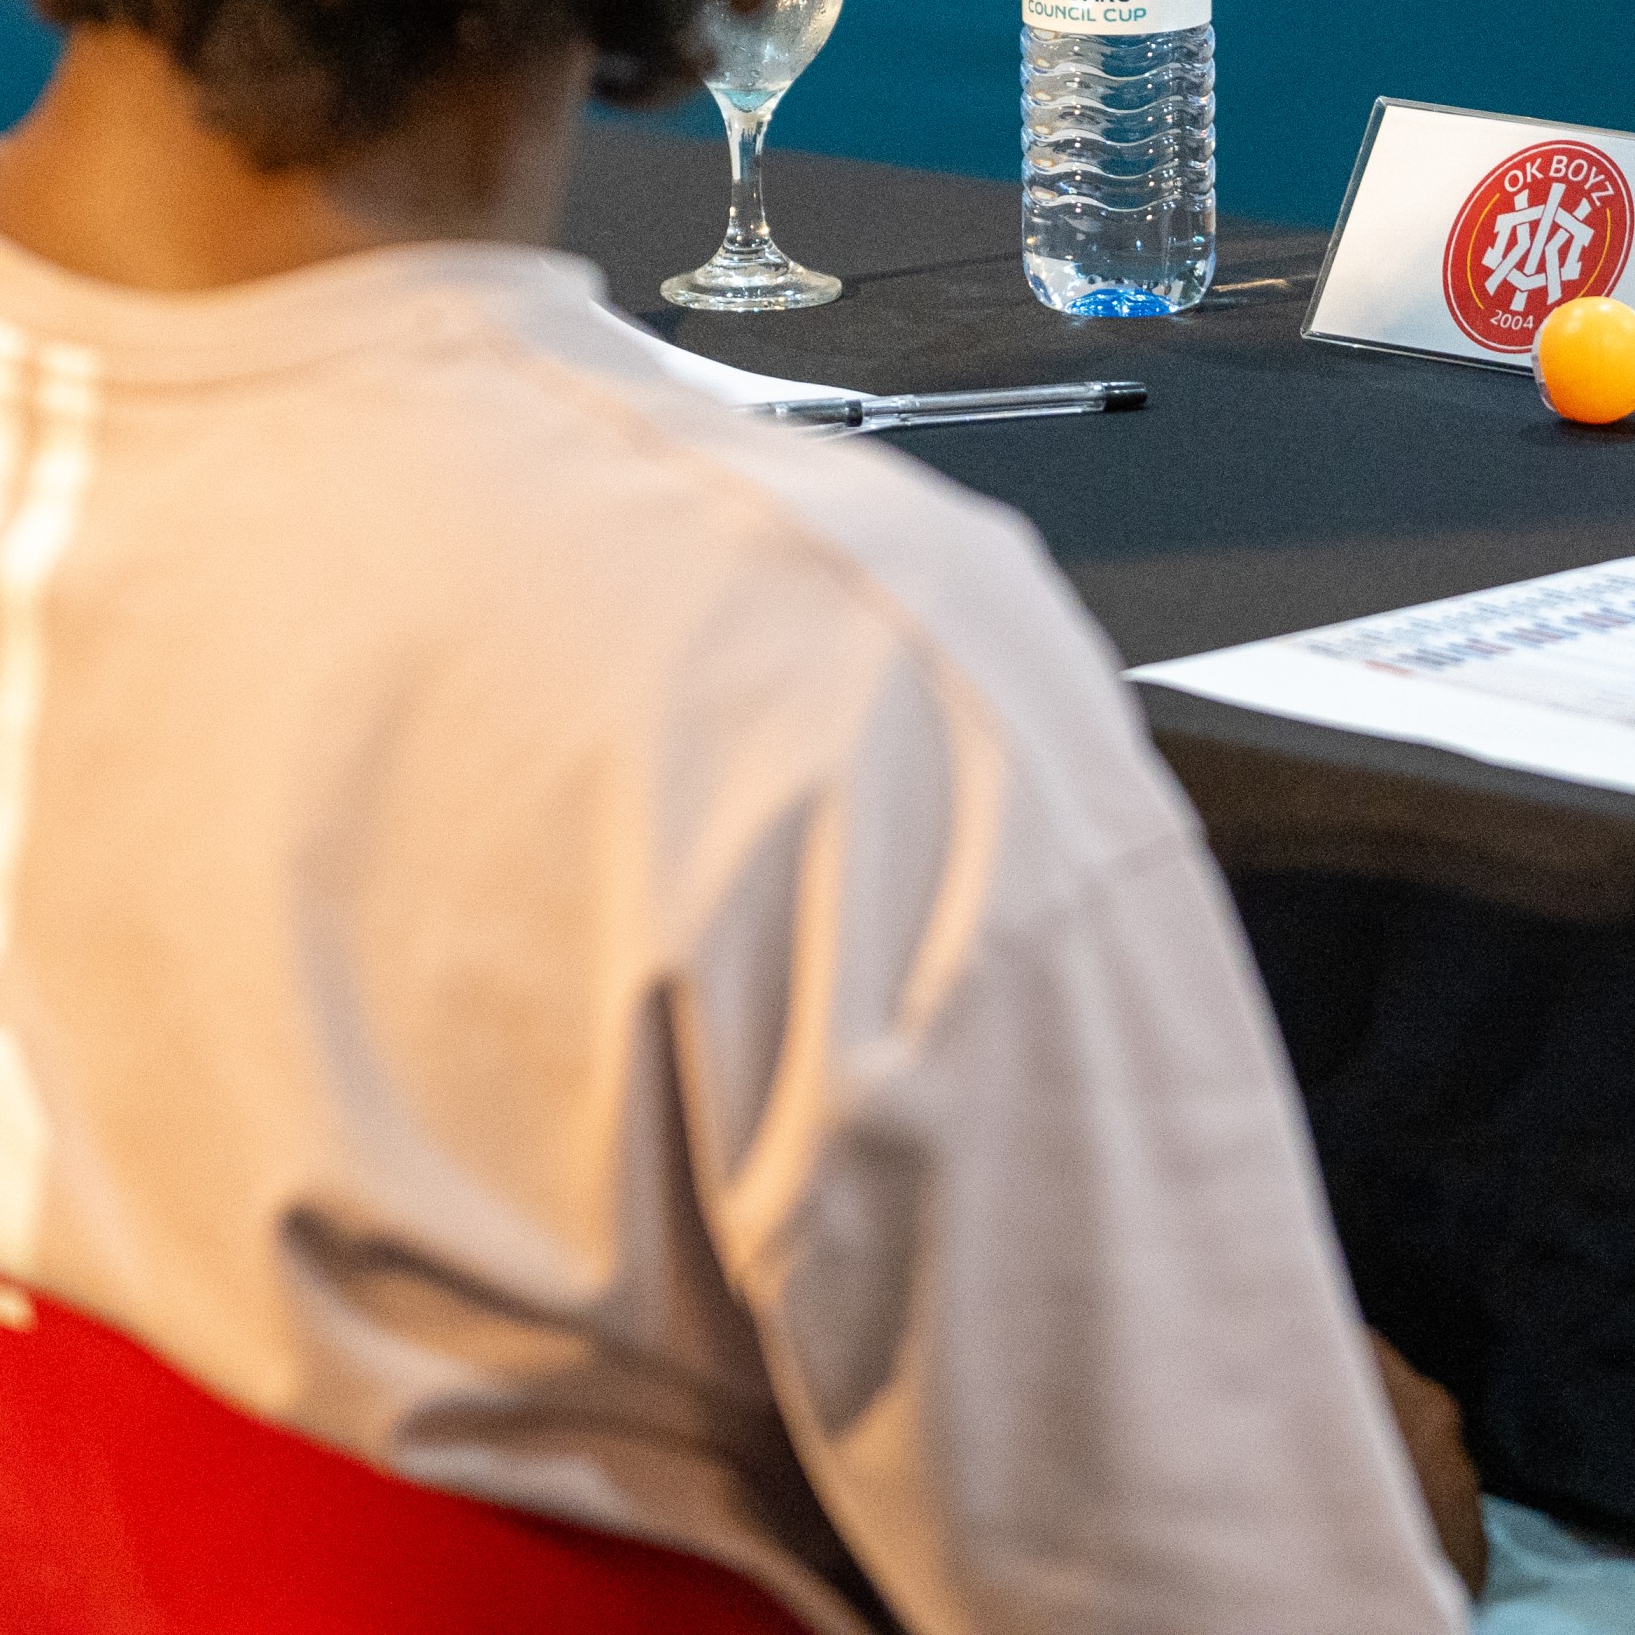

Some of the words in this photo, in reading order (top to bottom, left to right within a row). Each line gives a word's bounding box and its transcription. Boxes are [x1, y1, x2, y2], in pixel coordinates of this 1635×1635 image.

[1028, 0, 1096, 22] COUNCIL
[1103, 7, 1147, 22] CUP
[1504, 157, 1544, 192] OK
[1549, 155, 1615, 207] BOYZ
[1489, 310, 1535, 331] 2004
